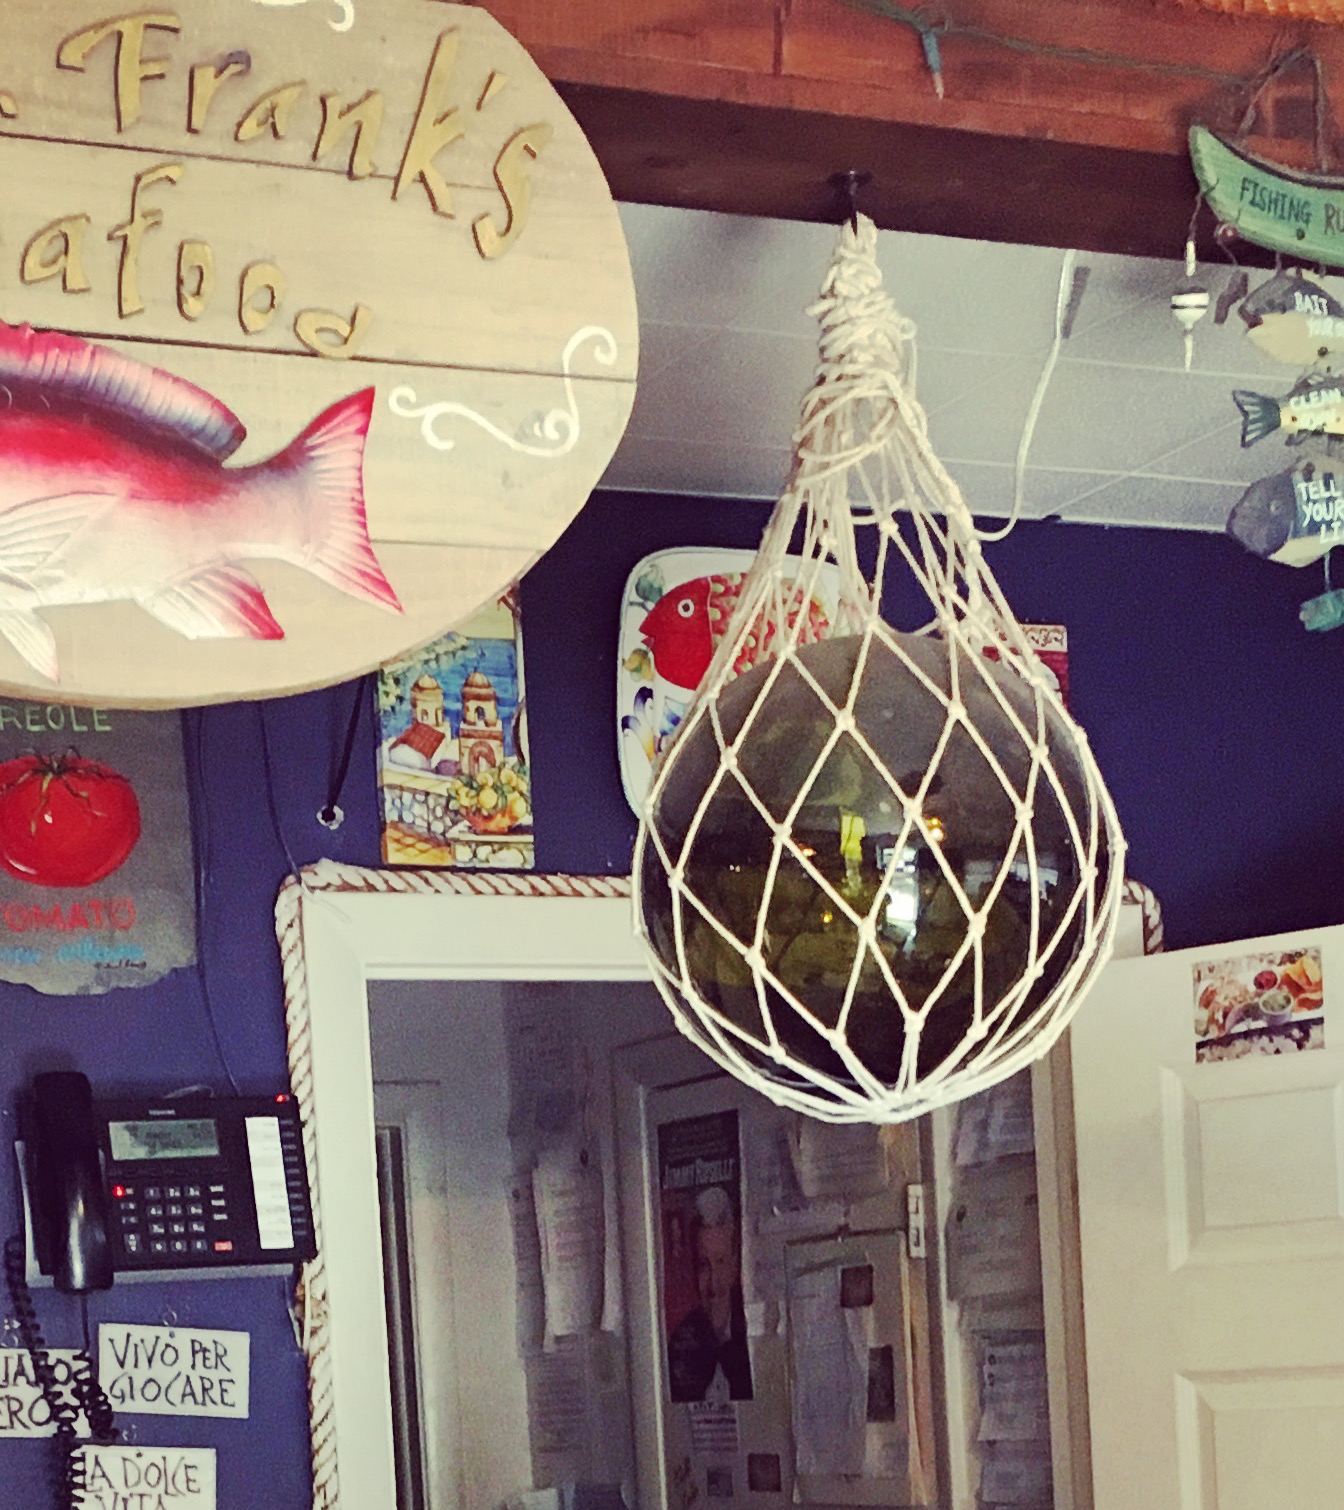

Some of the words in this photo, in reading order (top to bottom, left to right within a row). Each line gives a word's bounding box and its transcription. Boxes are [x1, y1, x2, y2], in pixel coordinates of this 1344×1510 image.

[56, 9, 552, 261] Frank's
[1239, 177, 1312, 227] FISHING
[1298, 481, 1341, 501] TELL
[191, 1338, 231, 1373] PER
[108, 1371, 236, 1408] GIOCARE
[121, 1455, 202, 1496] DOLCE
